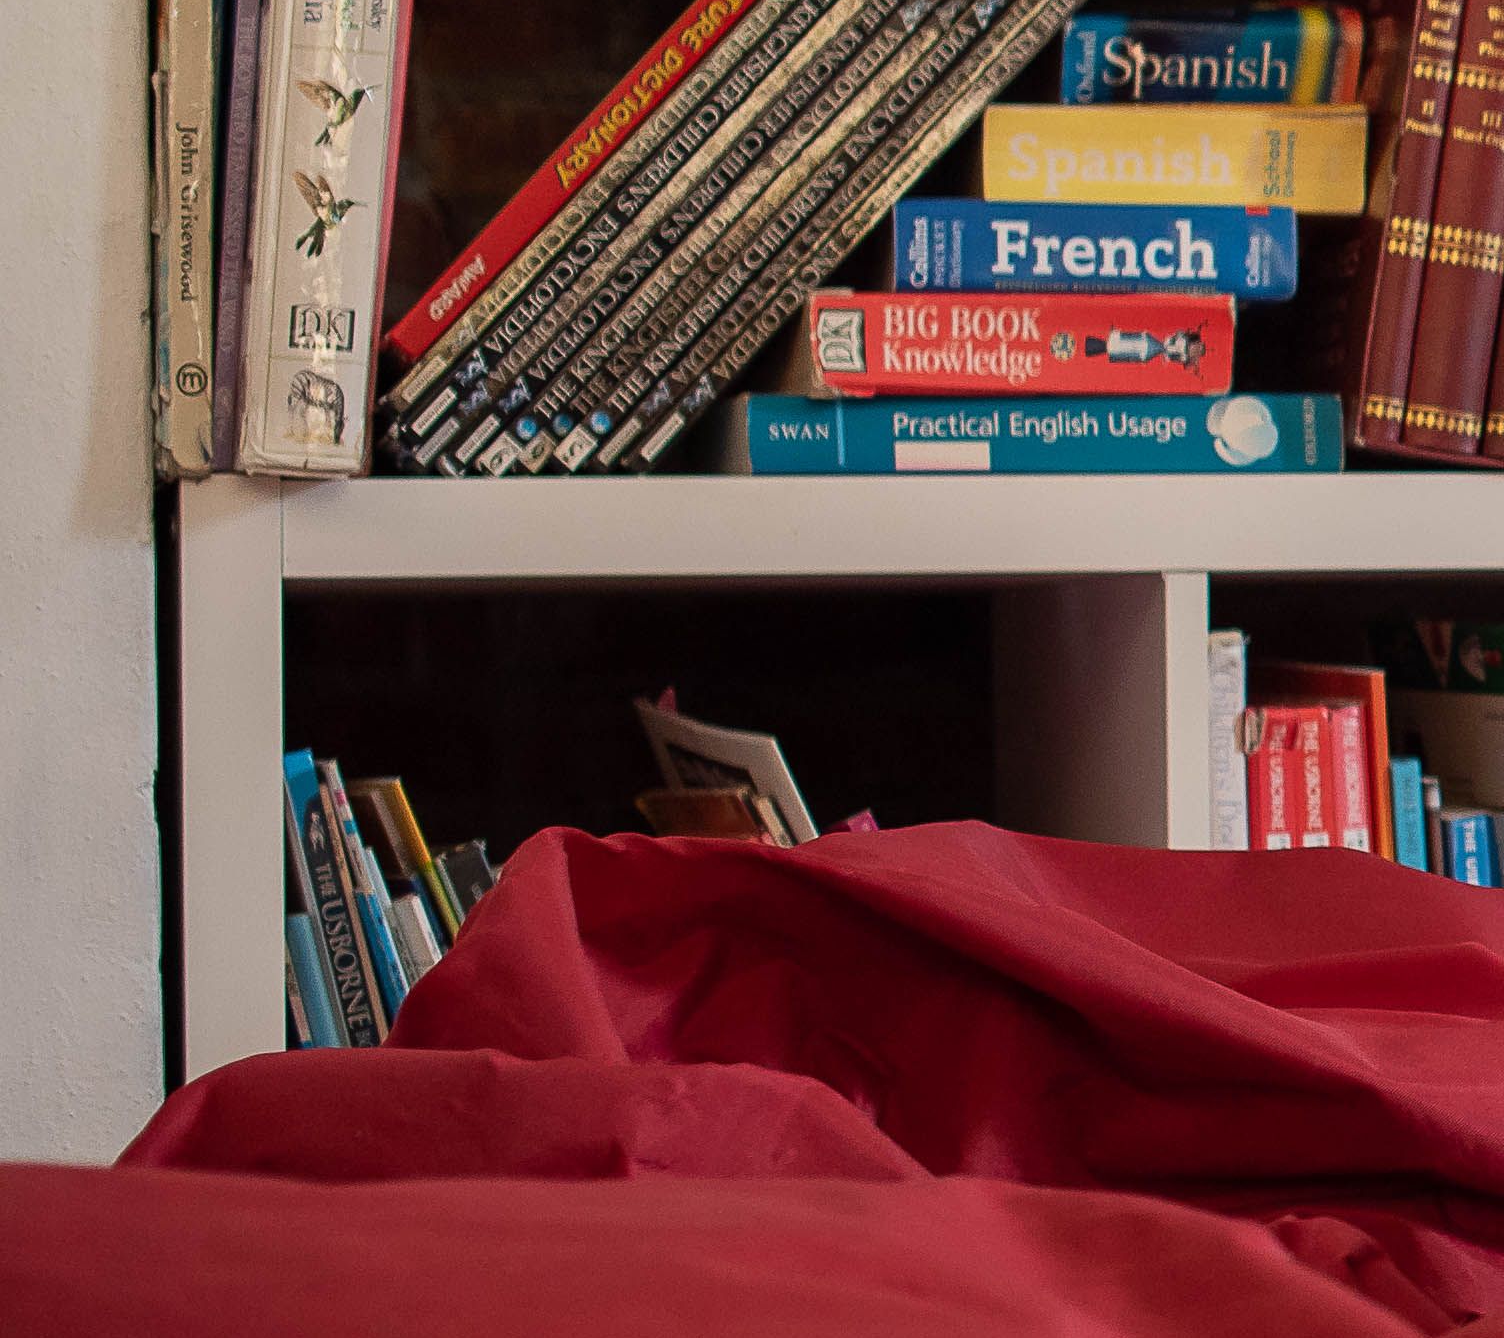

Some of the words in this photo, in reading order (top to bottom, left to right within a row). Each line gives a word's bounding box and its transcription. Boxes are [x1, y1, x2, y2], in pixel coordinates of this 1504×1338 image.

[1103, 35, 1290, 100] Spanish
[555, 36, 684, 191] DICTIONARY
[173, 122, 199, 175] John
[1005, 133, 1236, 198] Spanish
[607, 369, 651, 415] THE
[841, 19, 976, 161] ENCYCLOPEDIA
[991, 220, 1218, 280] French
[428, 254, 487, 324] AWARD
[482, 212, 622, 356] ENCYCLOPEDIA
[526, 240, 662, 385] ENCYCLOPEDIA
[820, 315, 856, 363] DK
[883, 306, 940, 339] BIG
[951, 305, 1042, 339] BOOK
[883, 342, 1042, 386] Knowledge
[533, 375, 577, 420] THE
[768, 423, 830, 442] SWAN
[893, 413, 1000, 438] Practical
[1010, 413, 1099, 445] English
[1108, 413, 1187, 445] Usage
[313, 862, 338, 899] THE
[313, 896, 379, 1032] USBORNE
